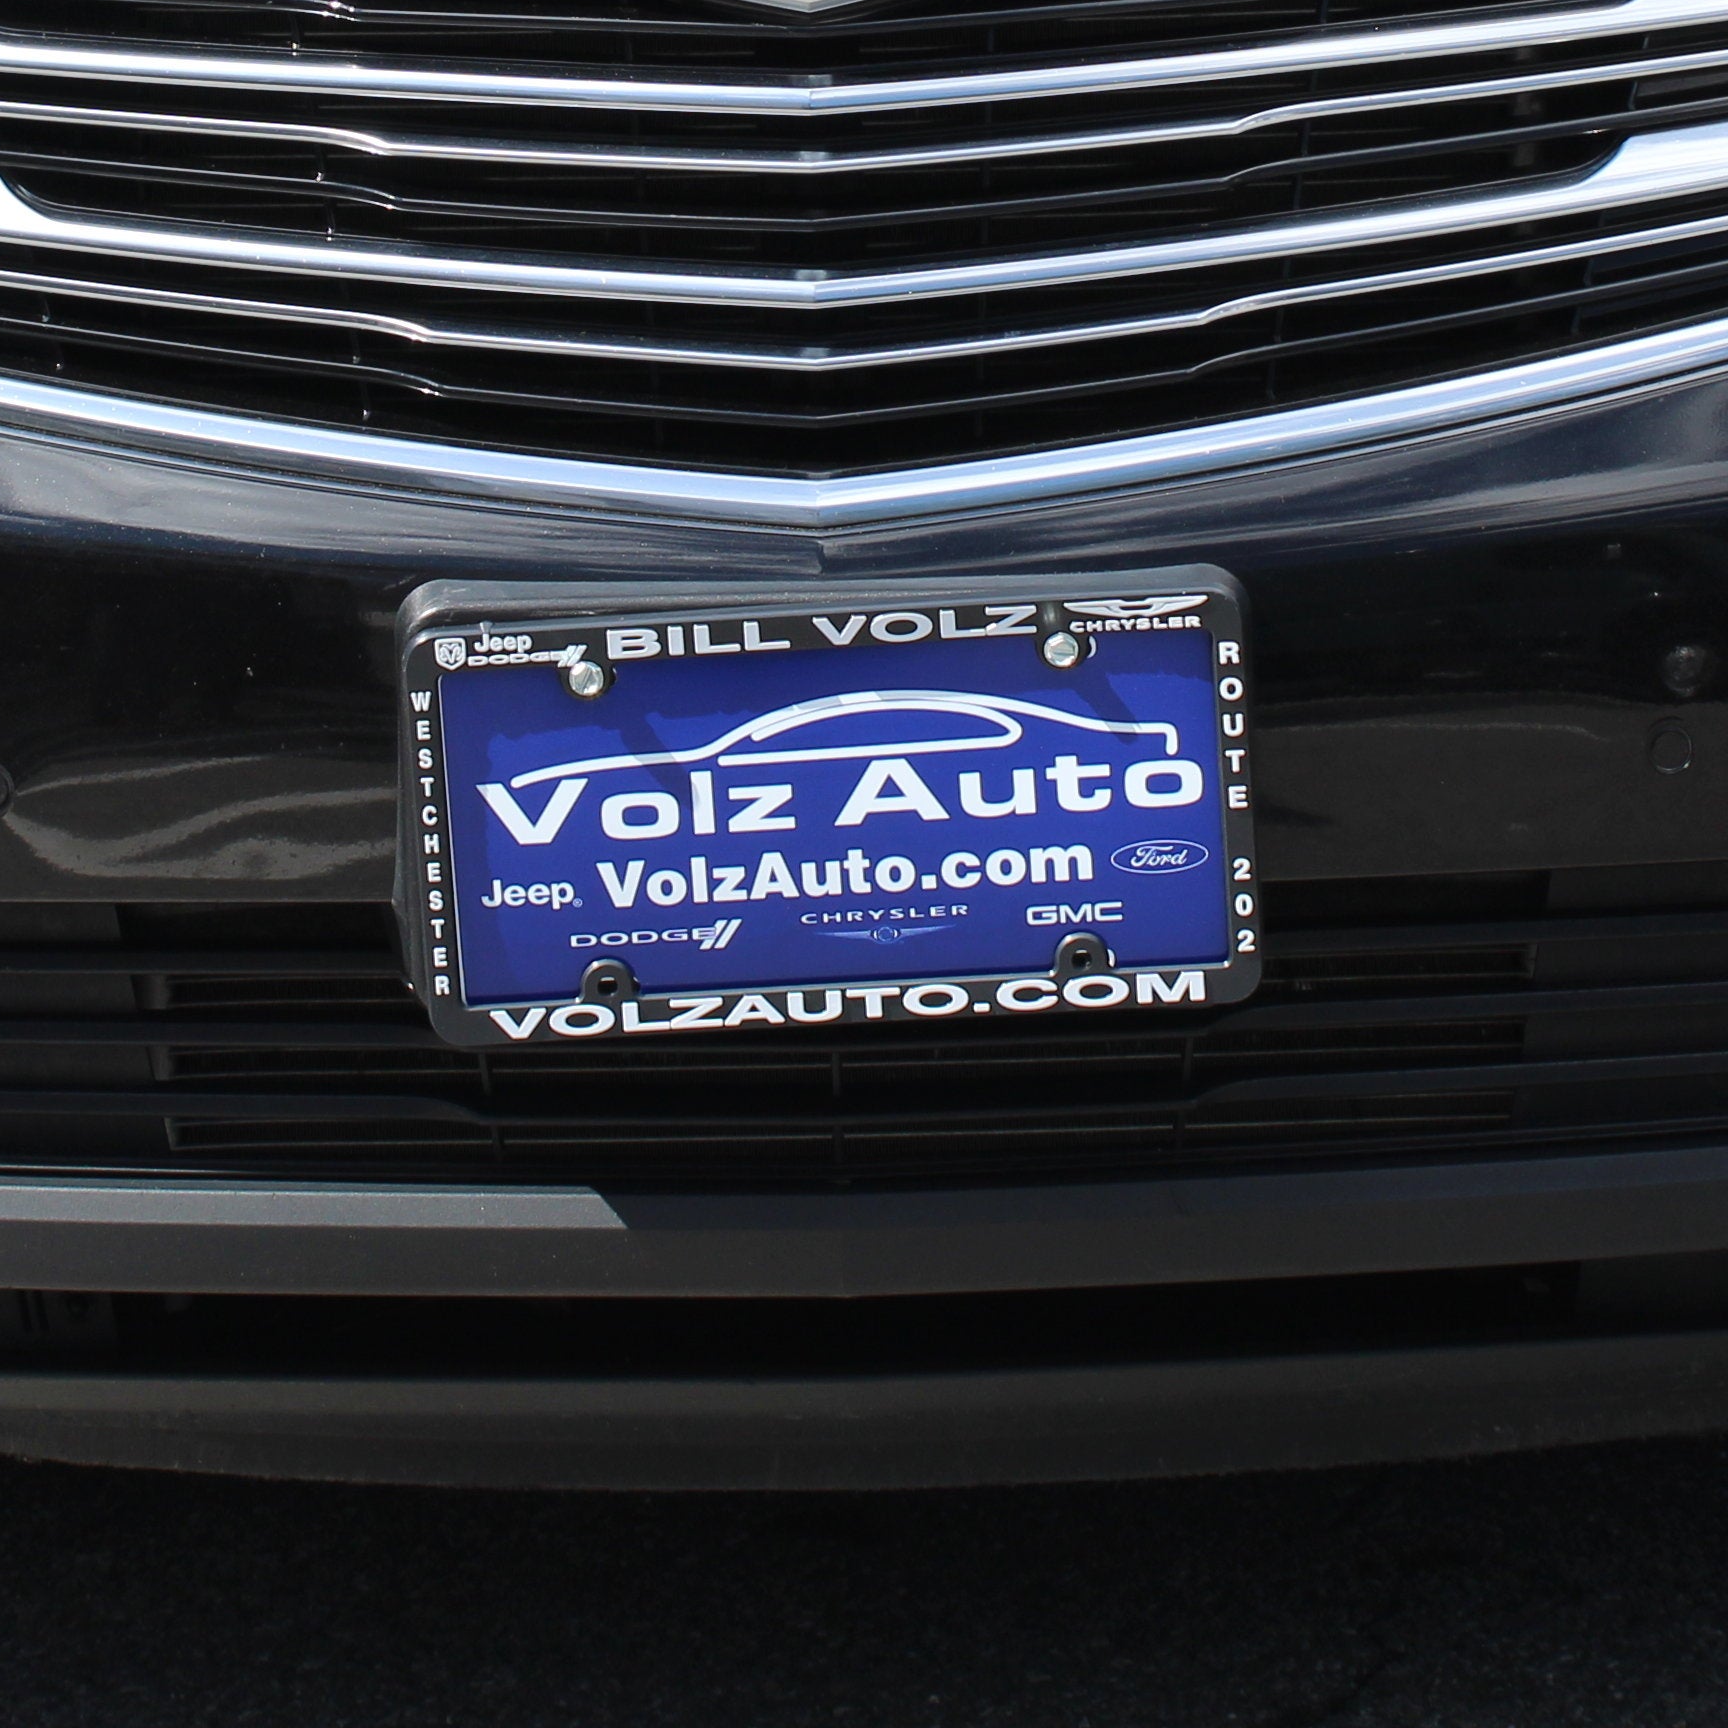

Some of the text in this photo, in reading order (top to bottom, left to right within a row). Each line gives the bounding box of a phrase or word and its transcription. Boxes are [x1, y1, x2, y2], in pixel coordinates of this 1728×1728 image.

[474, 633, 532, 653] Jeep
[606, 604, 1038, 660] BILL VOLZ
[1069, 615, 1202, 633] CHRYSLER
[475, 754, 1204, 846] Volz Auto
[1218, 640, 1256, 953] ROUTE 202
[410, 690, 450, 996] WESTCHESTER
[1130, 844, 1189, 869] Ford
[595, 843, 1094, 908] VolzAuto.com
[800, 903, 969, 924] CHRYSLER
[1025, 901, 1124, 927] GMC
[570, 926, 719, 948] DODGE
[489, 970, 1207, 1040] VOLZAUTO.COM
